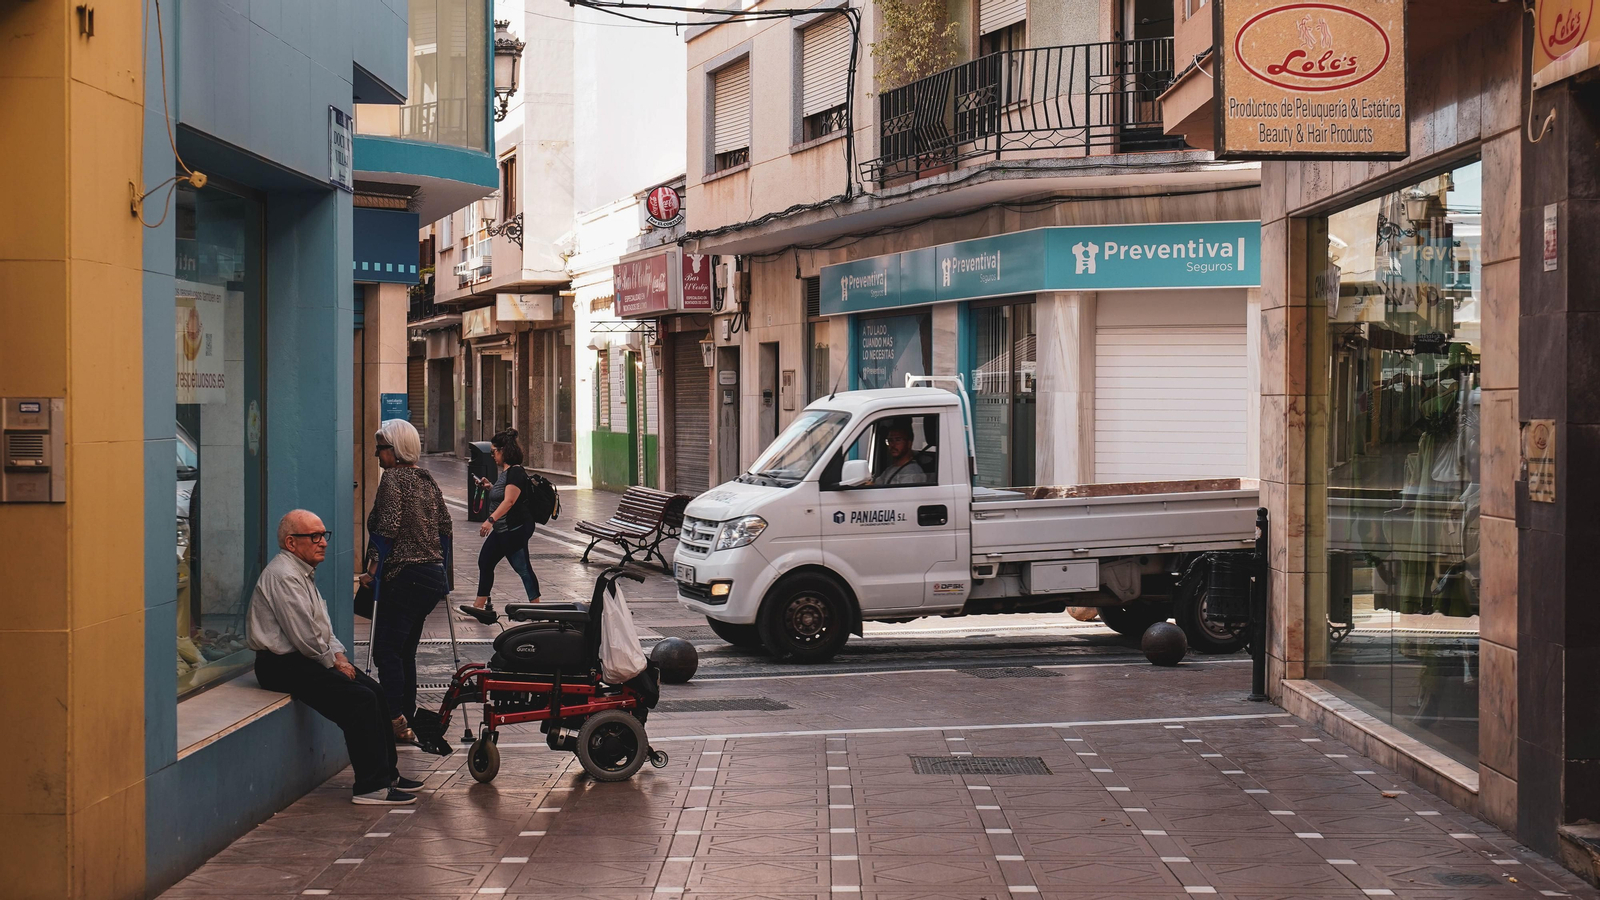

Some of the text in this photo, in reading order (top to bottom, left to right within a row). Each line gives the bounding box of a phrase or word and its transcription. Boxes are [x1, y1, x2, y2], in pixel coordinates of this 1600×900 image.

[1229, 98, 1401, 121] Productos de Peluquería & Estética
[1259, 123, 1373, 147] Beauty & Hair Products
[1104, 238, 1233, 260] Preventiva
[952, 253, 997, 274] Preventiva
[1186, 262, 1233, 273] Seguros
[684, 273, 699, 281] Bar
[849, 270, 884, 289] Preventiva
[979, 273, 996, 283] Seguros
[684, 282, 691, 291] El
[870, 289, 884, 298] Seguros
[862, 325, 887, 336] A TU LADO
[862, 333, 893, 348] CUANDO MÁS
[863, 349, 894, 360] LO NECESITAS
[175, 372, 225, 393] respetuosos.es
[850, 510, 895, 523] PANIAGUA
